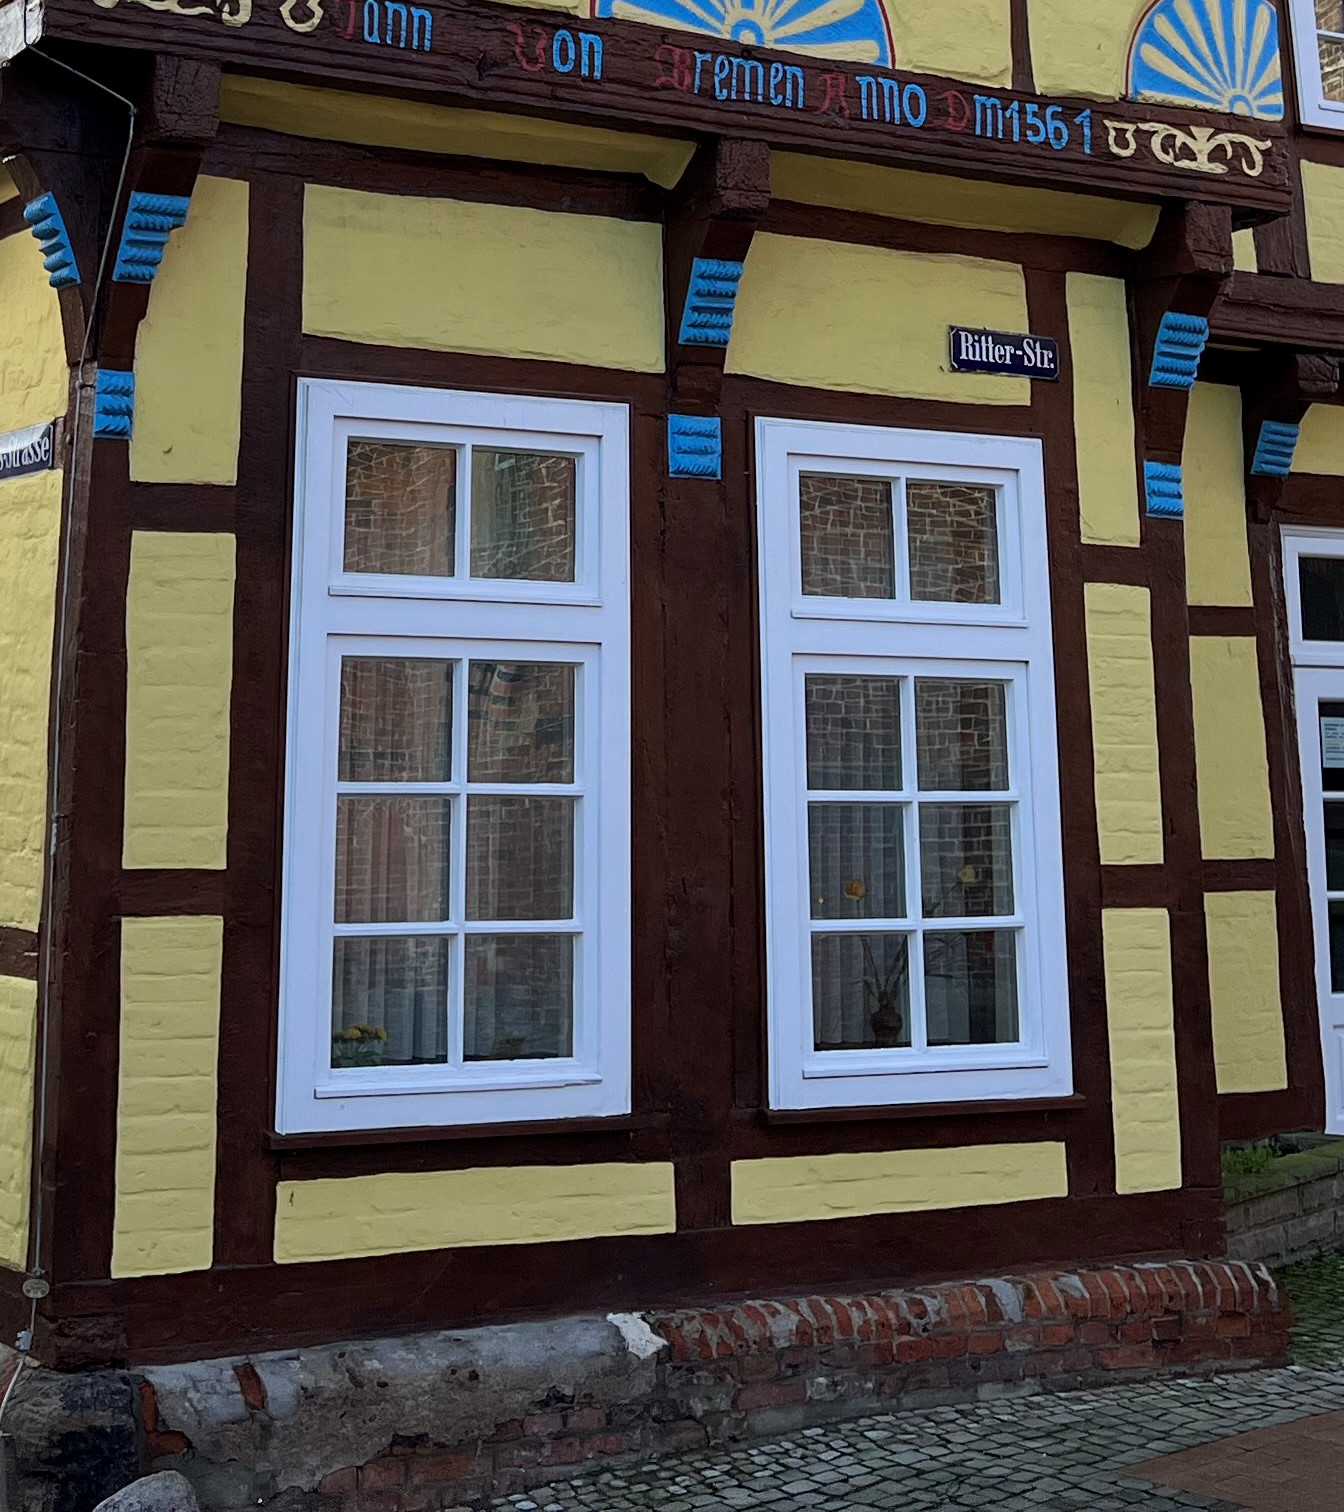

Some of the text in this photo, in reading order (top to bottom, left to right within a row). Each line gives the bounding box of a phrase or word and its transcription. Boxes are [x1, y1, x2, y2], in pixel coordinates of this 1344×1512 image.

[505, 22, 603, 81] Von
[655, 44, 805, 109] Bremen
[815, 72, 927, 128] Anno
[958, 330, 1055, 369] Ritter-Str.
